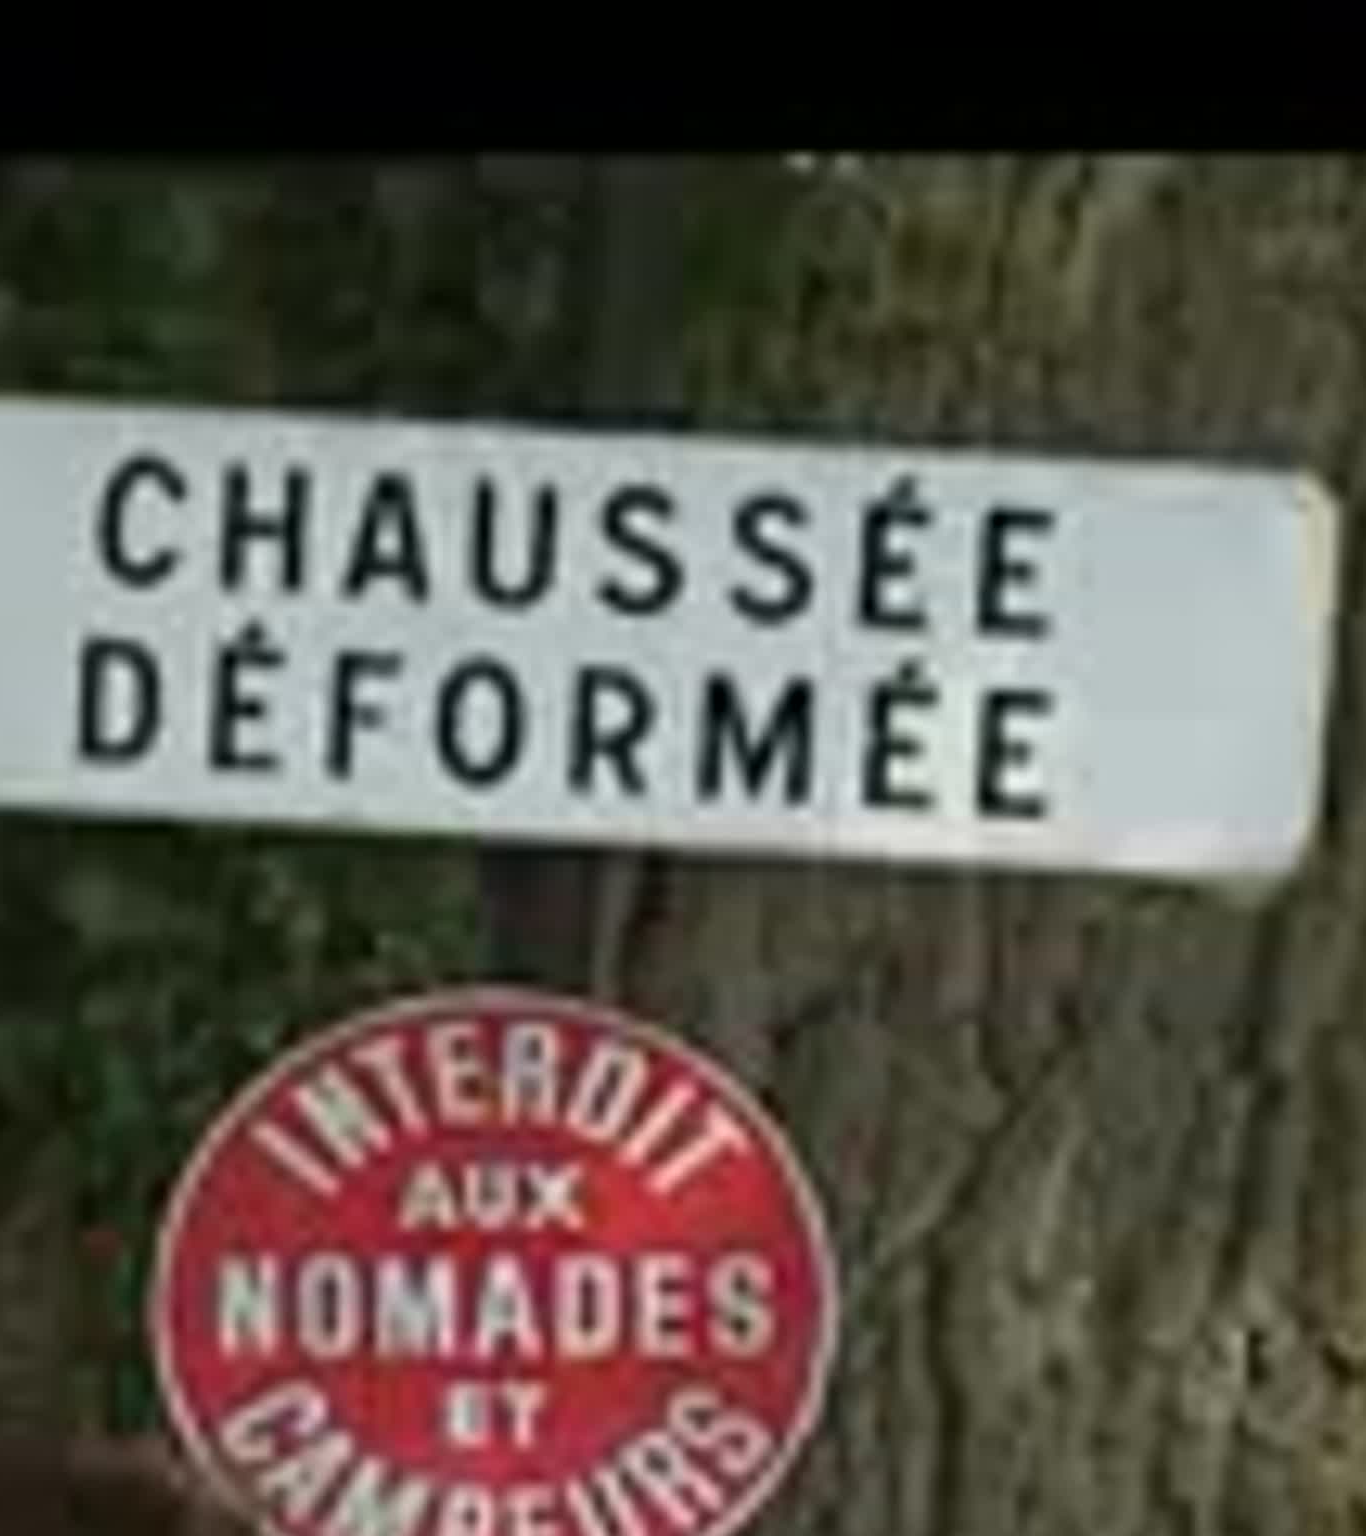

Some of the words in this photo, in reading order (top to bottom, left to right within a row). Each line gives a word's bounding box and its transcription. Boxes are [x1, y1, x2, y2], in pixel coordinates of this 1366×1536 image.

[93, 450, 1057, 642] CHAUSSÉE
[73, 618, 1055, 822] DÉFORMÉE
[250, 1022, 751, 1194] INTERDIT
[399, 1163, 585, 1230] AUX
[217, 1252, 775, 1358] NOMADES
[444, 1380, 547, 1447] ET
